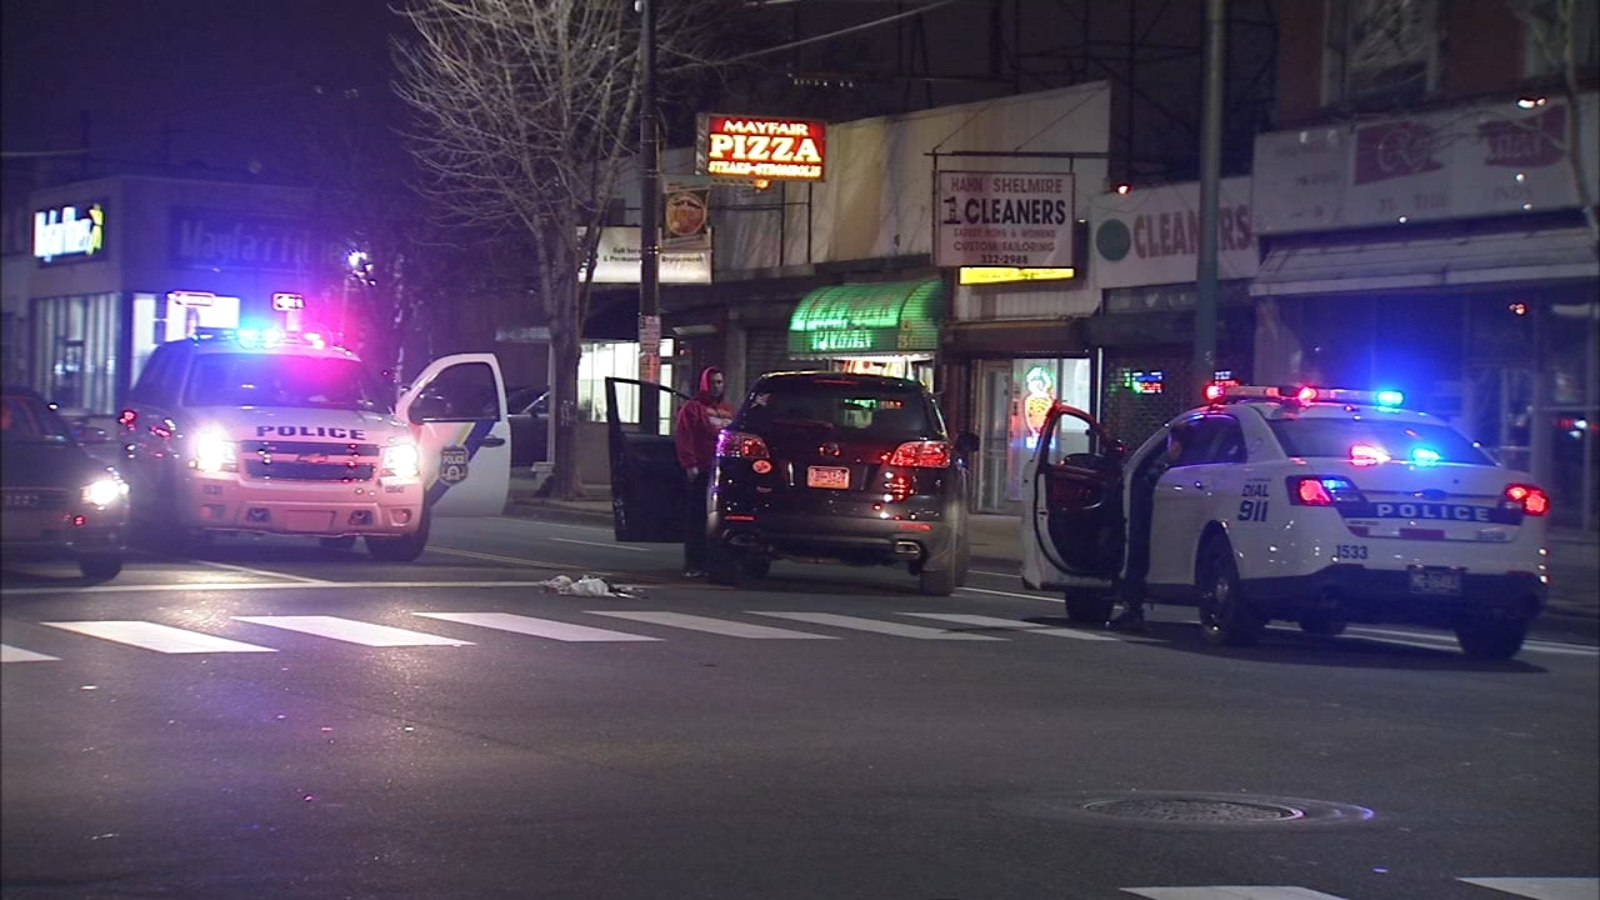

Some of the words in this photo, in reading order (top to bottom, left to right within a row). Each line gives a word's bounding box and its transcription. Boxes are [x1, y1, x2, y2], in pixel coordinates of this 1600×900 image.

[723, 120, 809, 136] MAYFAIR
[709, 133, 822, 162] PIZZA
[951, 177, 983, 192] HAHN
[993, 178, 1062, 194] SHELMIRE
[965, 198, 1066, 225] CLEANERS
[1133, 204, 1252, 260] CLEANRS
[1002, 241, 1056, 252] TAILORING
[256, 425, 366, 440] POLICE
[443, 454, 466, 465] POLICE
[1241, 484, 1269, 497] DIAL
[1237, 499, 1268, 522] 911
[1376, 503, 1490, 521] POLICE
